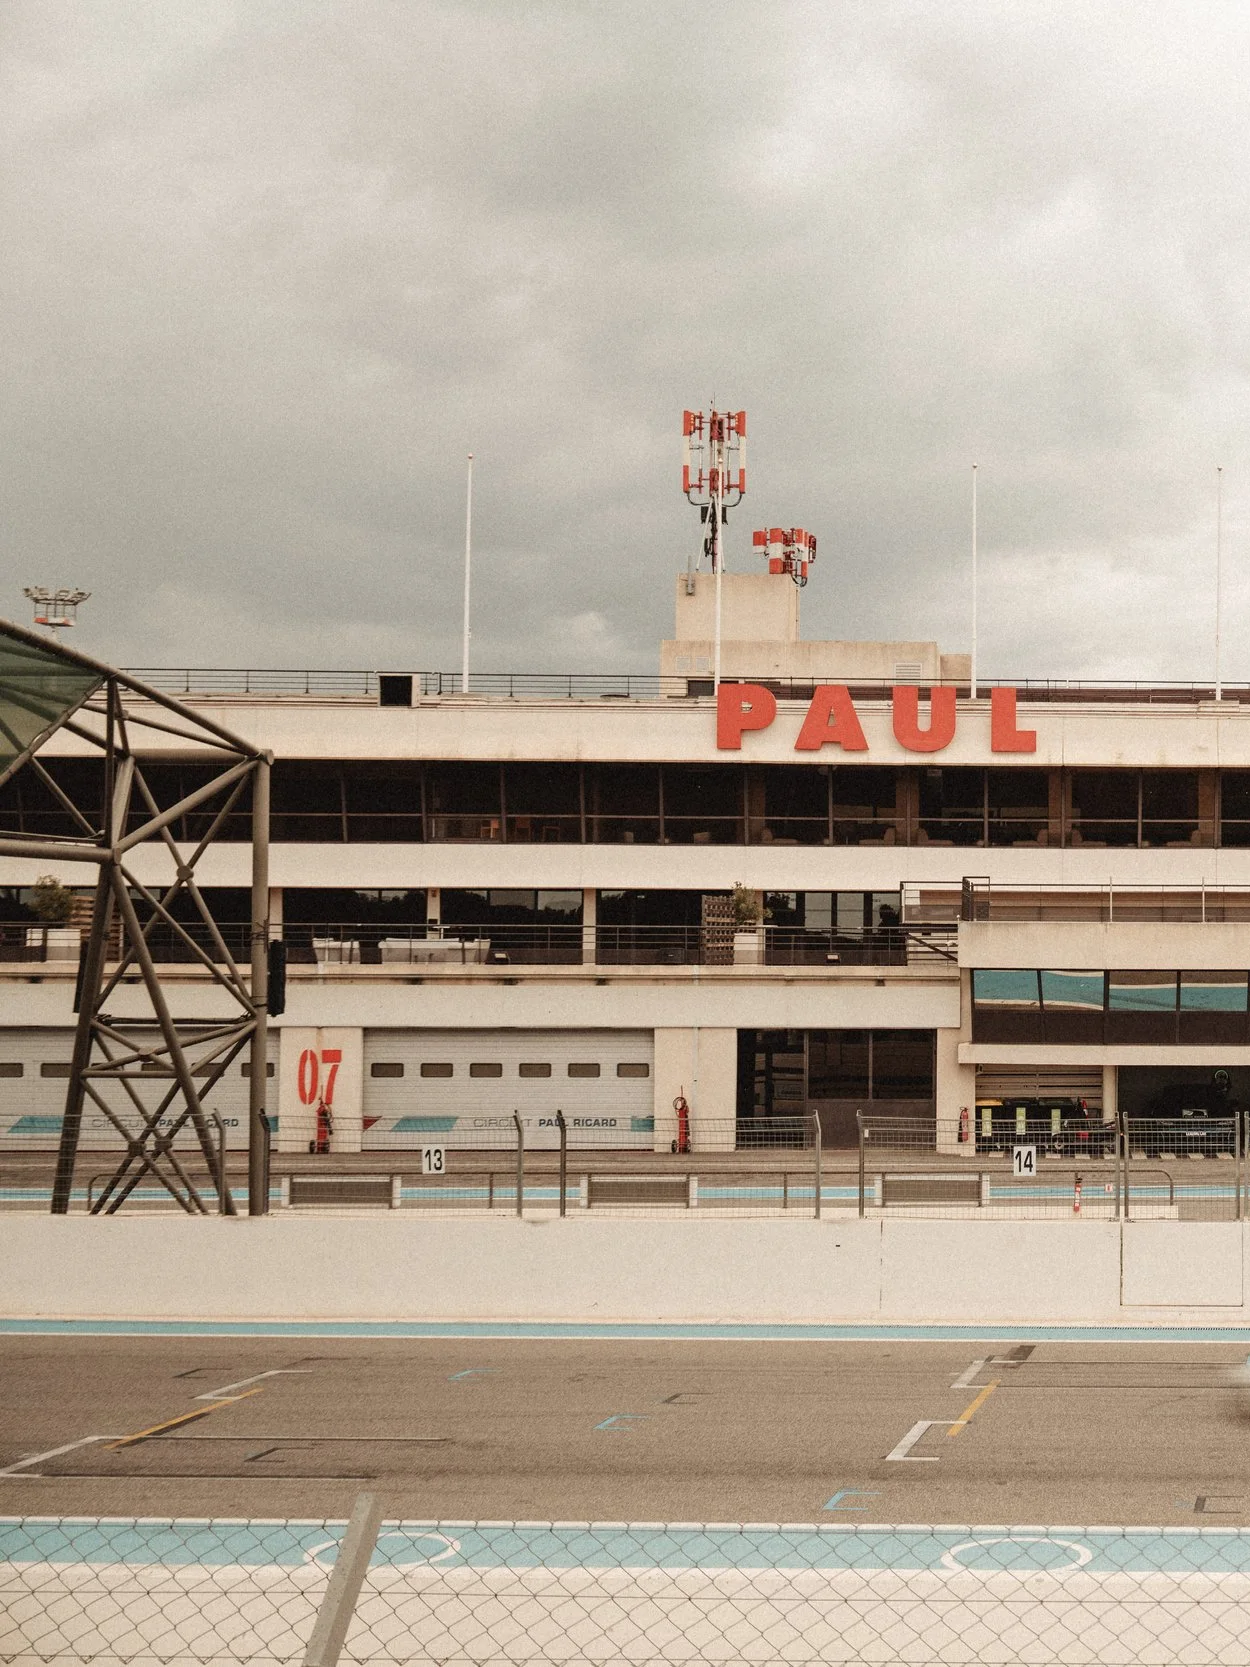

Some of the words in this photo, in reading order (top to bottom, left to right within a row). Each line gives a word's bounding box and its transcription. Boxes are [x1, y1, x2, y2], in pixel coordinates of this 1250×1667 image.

[716, 683, 1037, 753] PAUL
[298, 1049, 342, 1105] 07
[573, 1118, 617, 1127] RICARD
[425, 1149, 443, 1171] 13
[1015, 1150, 1034, 1173] 14
